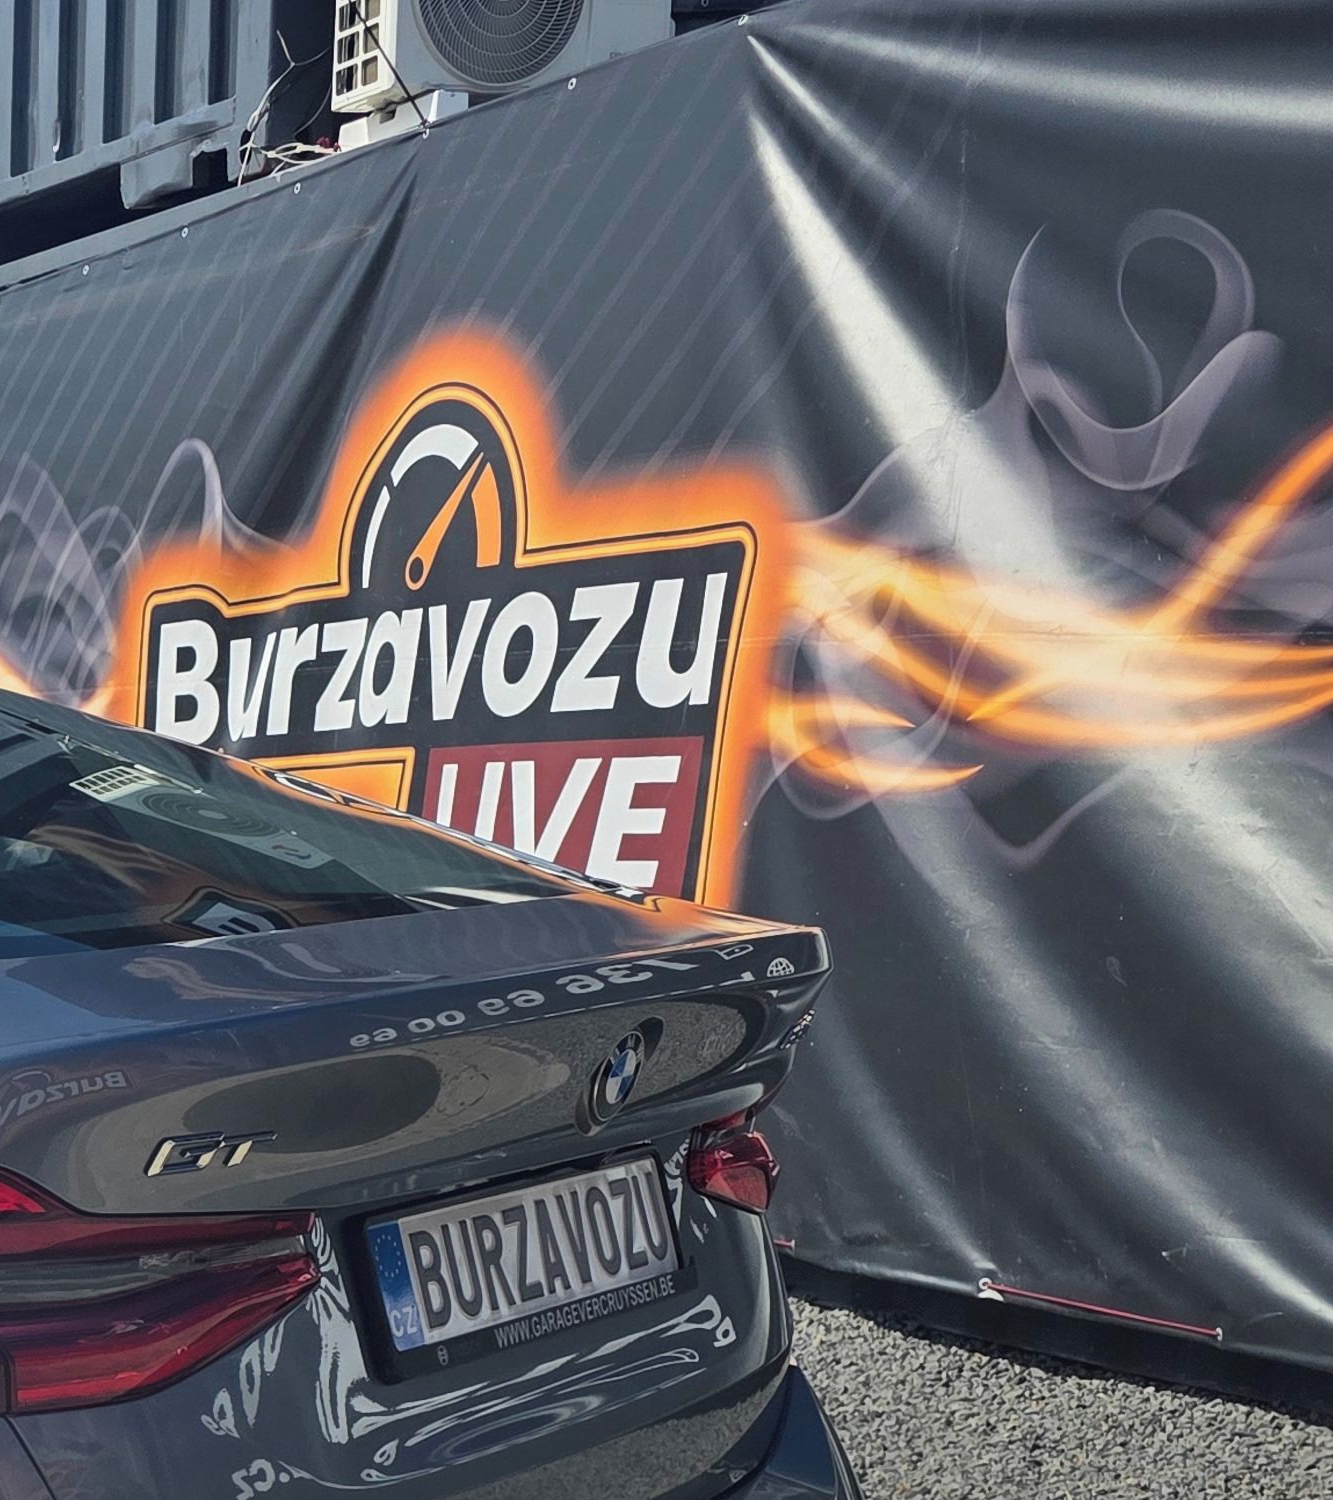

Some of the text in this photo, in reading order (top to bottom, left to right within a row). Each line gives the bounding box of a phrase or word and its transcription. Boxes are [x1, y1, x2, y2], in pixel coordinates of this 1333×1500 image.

[154, 572, 728, 746] Burzavozu
[144, 1130, 278, 1177] GT
[409, 1169, 669, 1330] BURZAVOZU
[390, 1304, 419, 1338] CZ
[494, 1273, 675, 1349] WWW.GARAGEVERCRUYSSEN.BE
